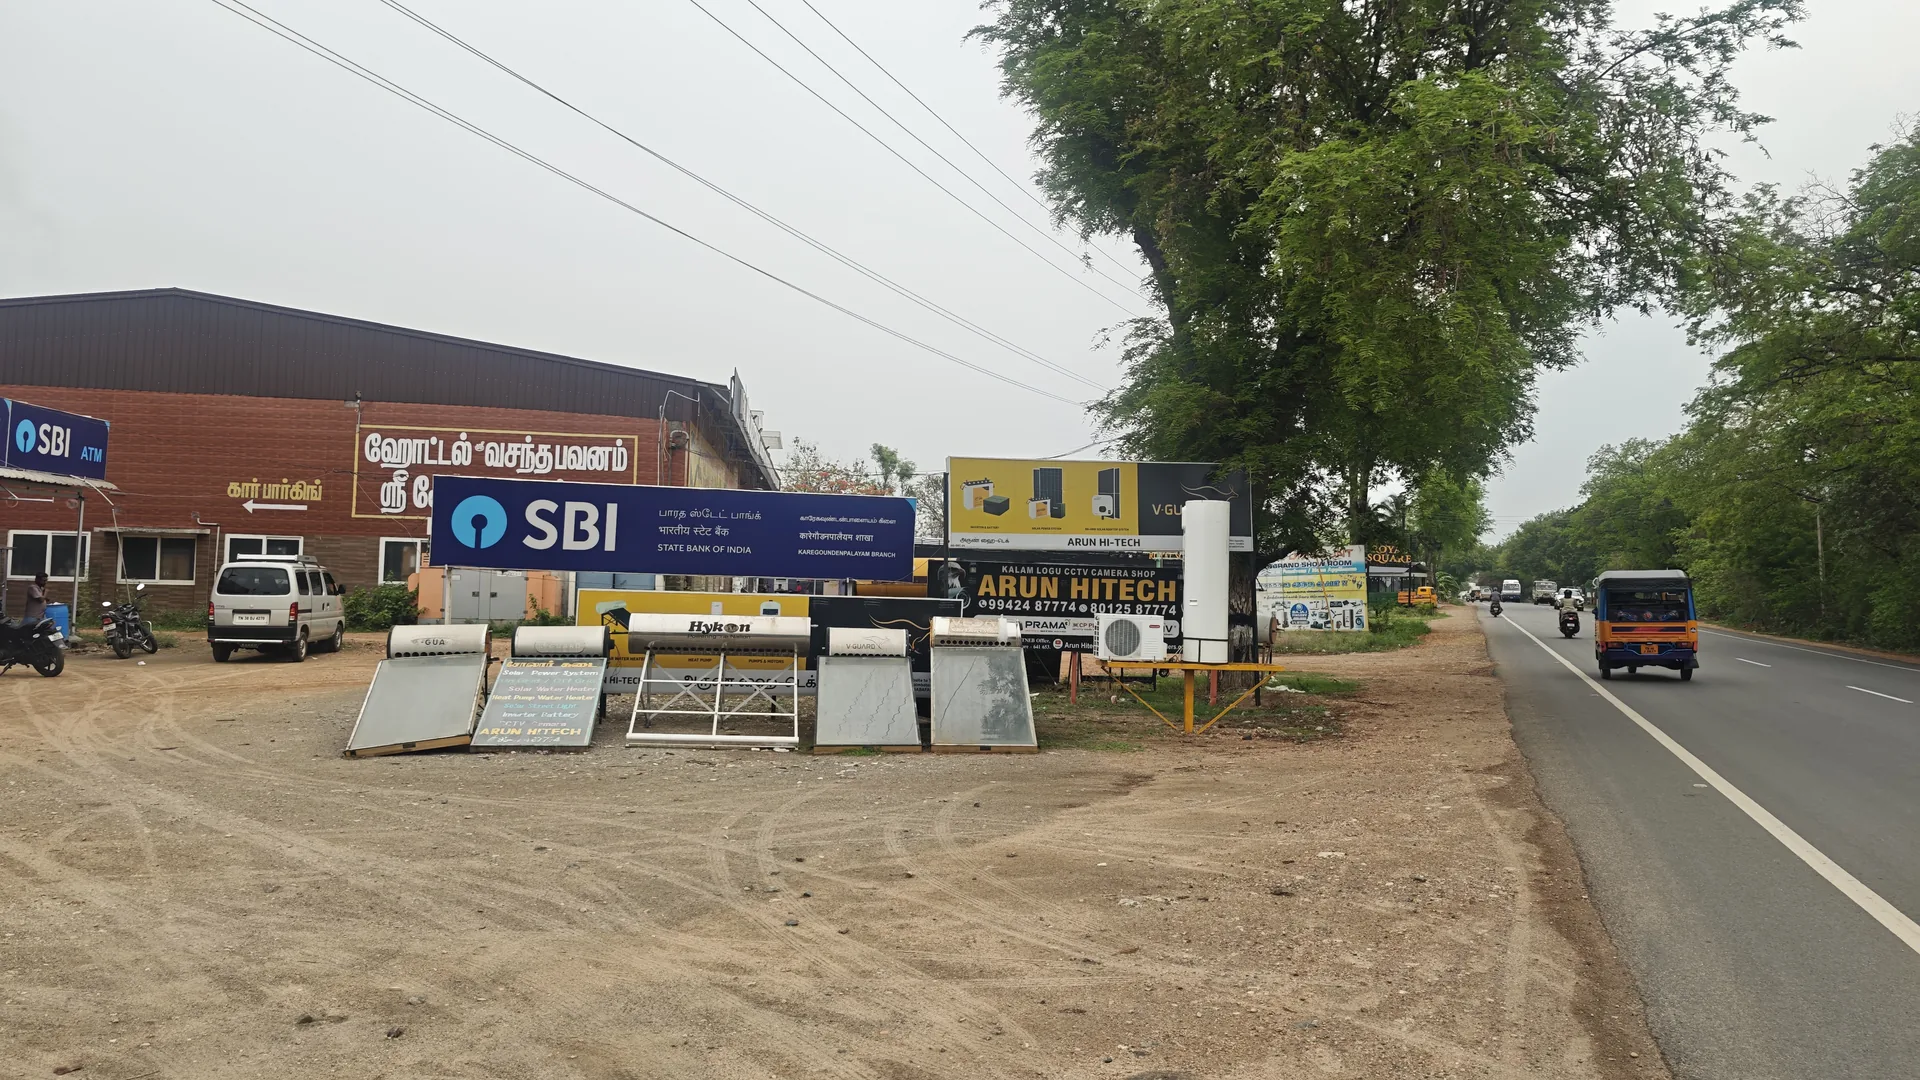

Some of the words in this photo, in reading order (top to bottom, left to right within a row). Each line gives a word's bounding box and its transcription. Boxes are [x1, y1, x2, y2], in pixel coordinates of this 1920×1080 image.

[37, 423, 71, 458] SBI
[80, 445, 103, 463] ATM
[364, 431, 472, 469] ஹோட்டல்
[226, 477, 261, 499] கார்
[262, 477, 323, 501] பார்கிங்
[658, 509, 687, 520] பாரத
[689, 507, 728, 519] ஸ்டேட்
[522, 499, 618, 552] SBI
[658, 523, 691, 535] भारतीय
[693, 524, 712, 536] स्टेट
[714, 524, 730, 536] बैंक
[855, 533, 874, 542] शाखा
[1067, 538, 1097, 547] ARUN
[1099, 539, 1141, 547] HI-TECH
[657, 543, 685, 552] STATE
[686, 544, 711, 553] BANK
[712, 545, 725, 553] OF
[726, 546, 752, 554] INDIA
[797, 549, 870, 557] KAREGOUNDENPALAYAM
[1301, 560, 1325, 568] SHOW
[1367, 553, 1412, 564] SQUARE
[1001, 565, 1034, 575] KALAM
[1036, 566, 1062, 575] LOGU
[1064, 567, 1089, 576] CCTV
[1091, 568, 1128, 577] CAMERA
[1131, 569, 1156, 578] SHOP
[977, 574, 1059, 599] ARUN
[1070, 577, 1176, 602] HITECH
[988, 599, 1031, 611] 99424
[1034, 600, 1076, 613] 87774
[1090, 602, 1132, 614] 80125
[1135, 603, 1177, 616] 87774
[688, 621, 751, 634] Hykon
[1025, 620, 1066, 629] PRAMA
[562, 669, 599, 677] System
[479, 727, 522, 735] ARUN
[527, 727, 582, 735] HITECH
